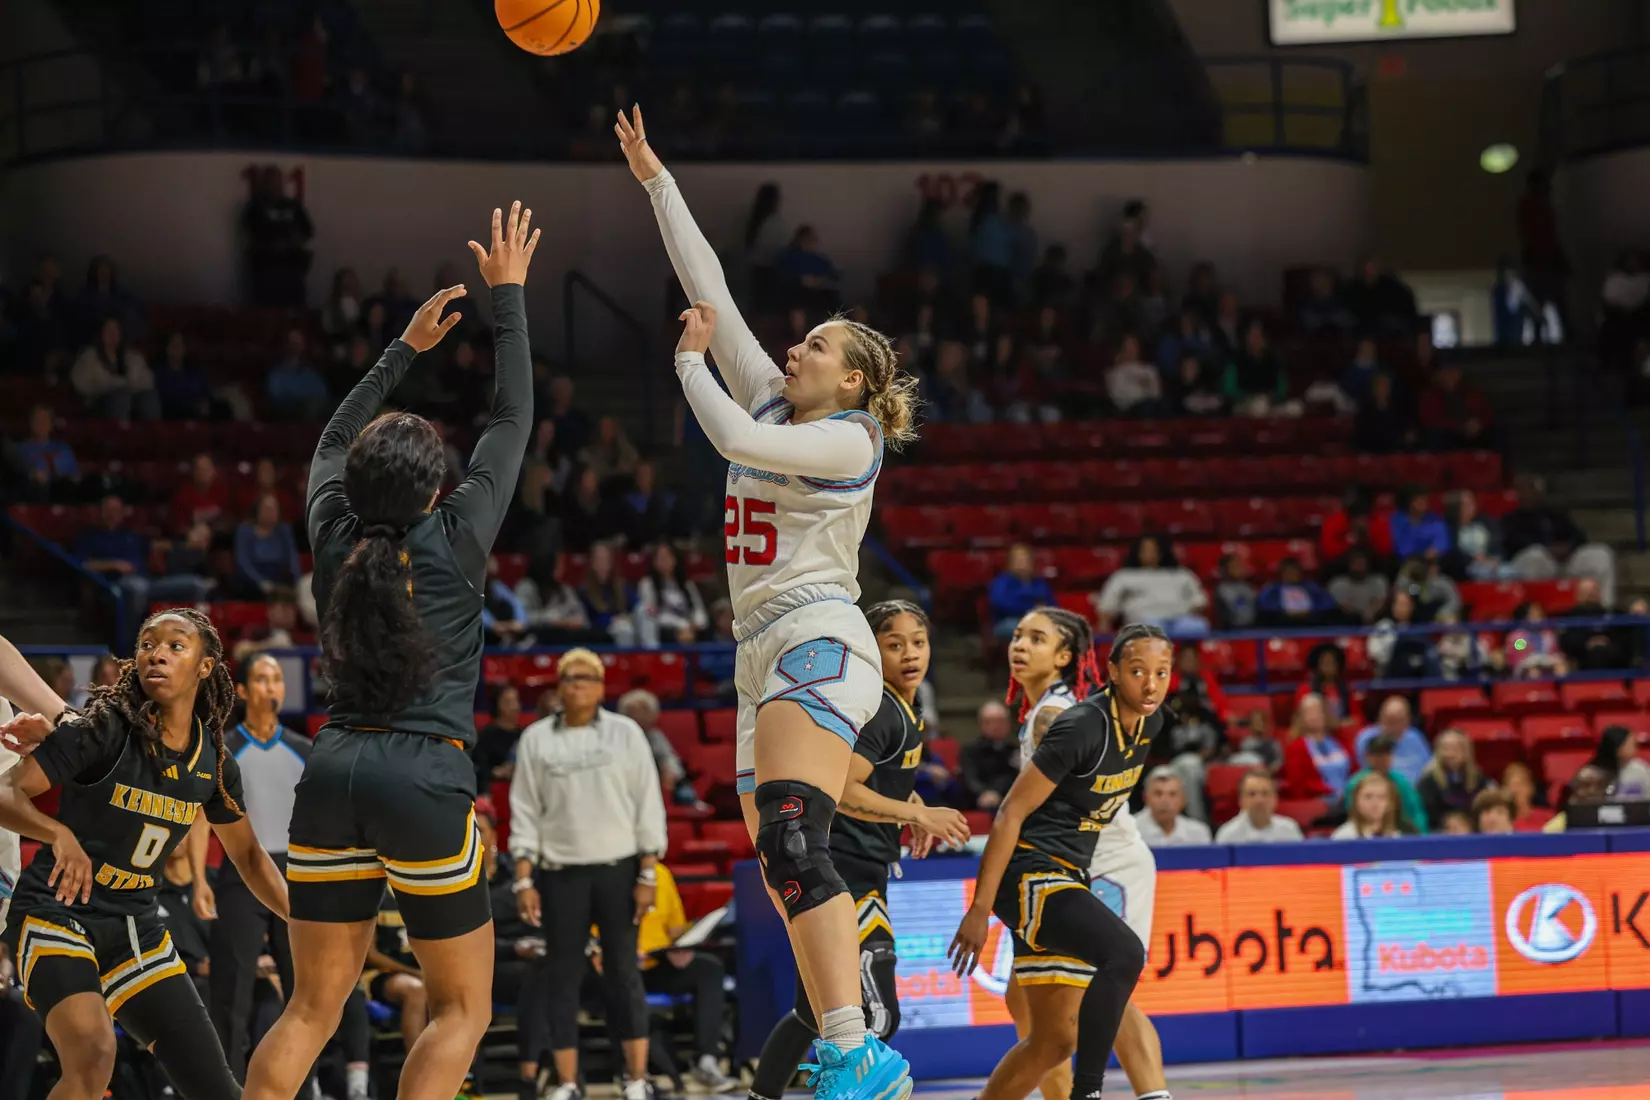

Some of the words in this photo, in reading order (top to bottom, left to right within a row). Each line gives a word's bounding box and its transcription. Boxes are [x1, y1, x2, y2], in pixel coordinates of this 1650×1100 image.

[725, 495, 778, 566] 25
[131, 823, 170, 868] 0
[1377, 942, 1490, 974] Kubota
